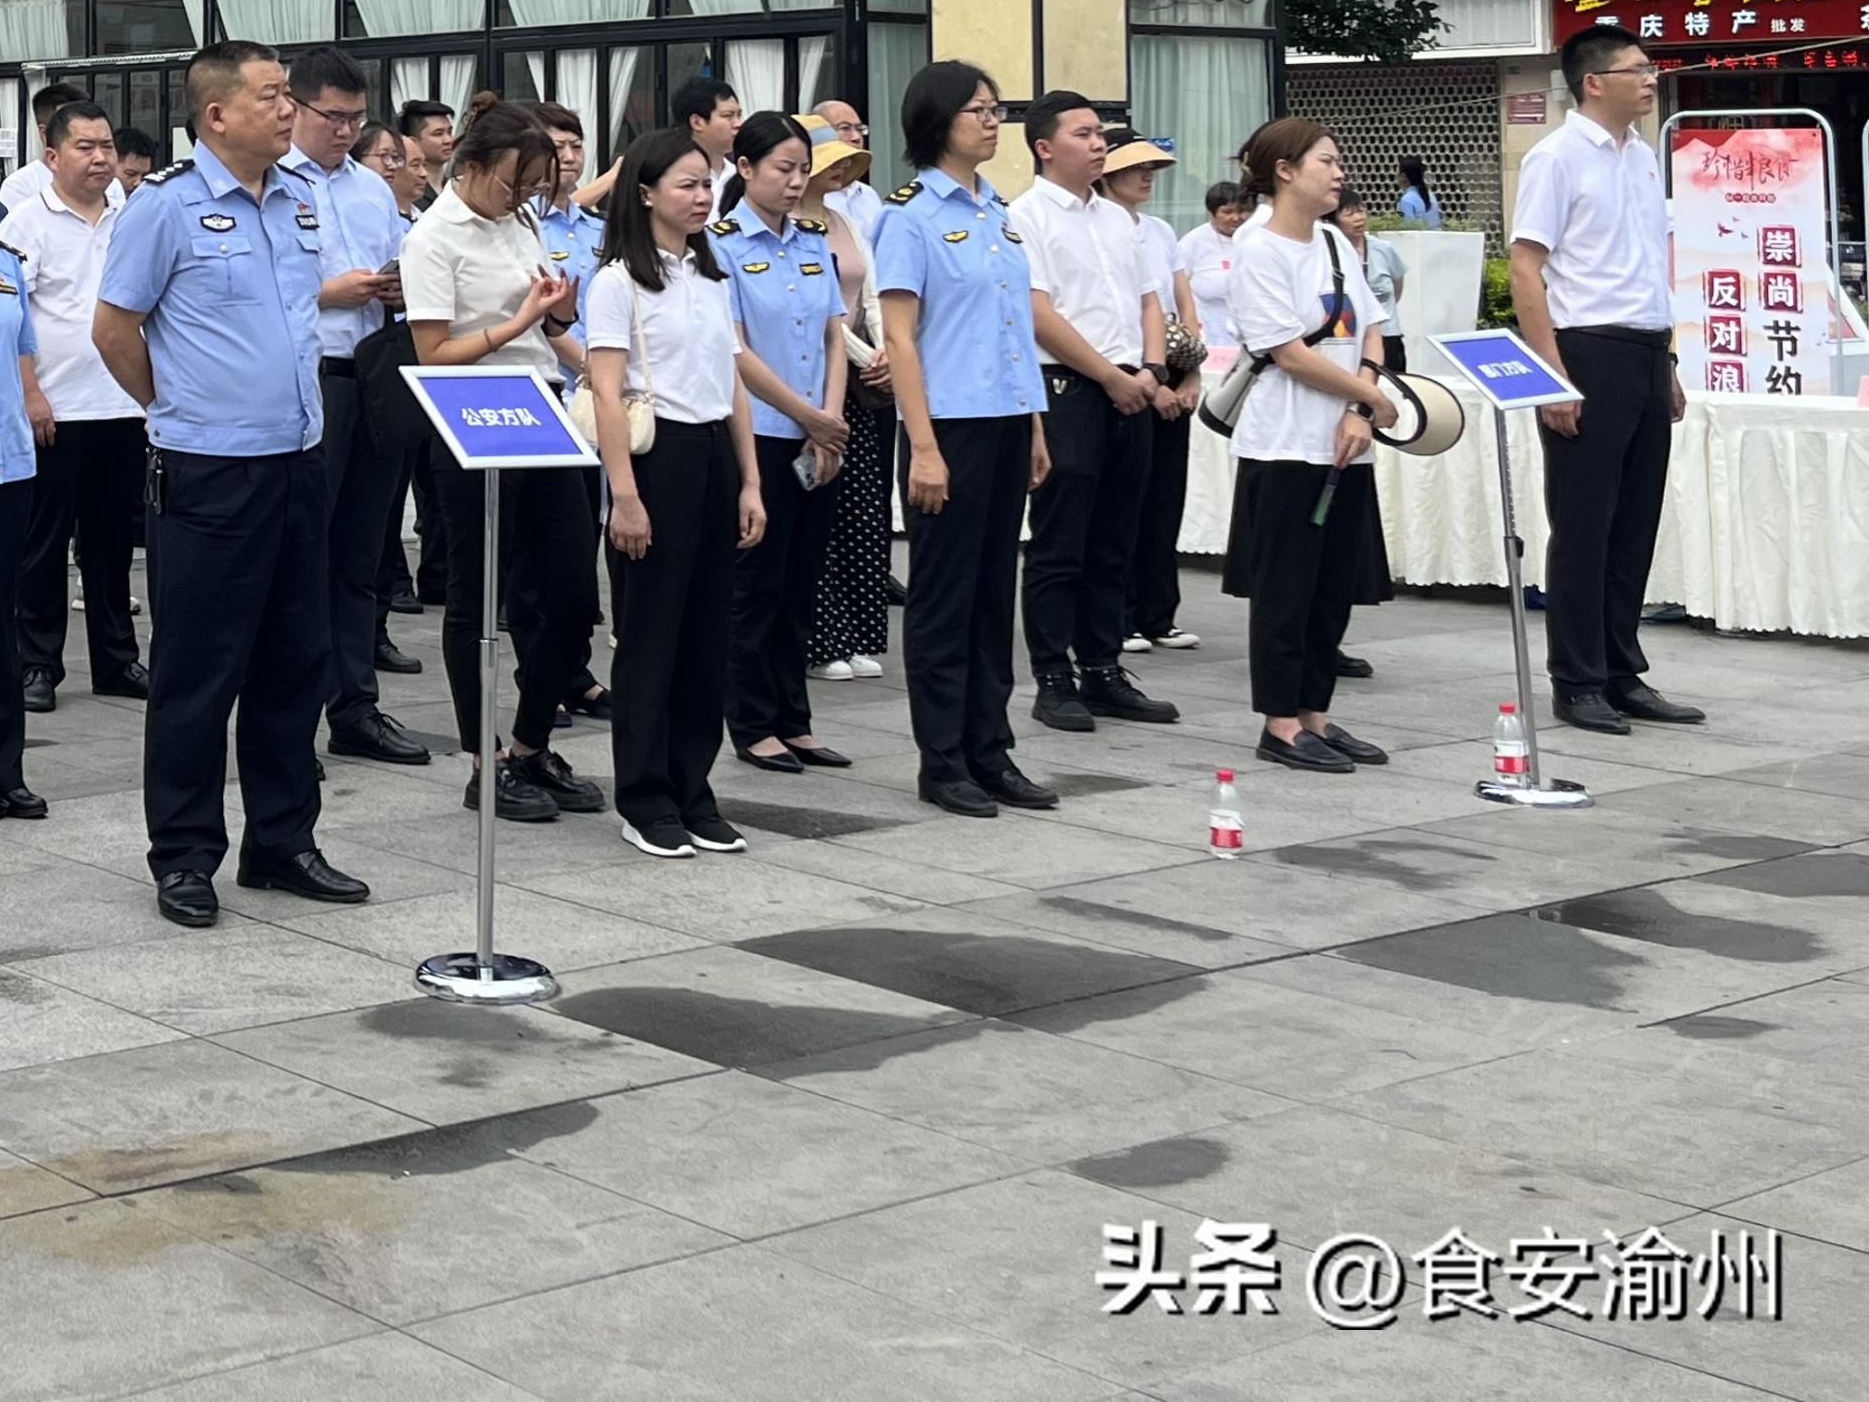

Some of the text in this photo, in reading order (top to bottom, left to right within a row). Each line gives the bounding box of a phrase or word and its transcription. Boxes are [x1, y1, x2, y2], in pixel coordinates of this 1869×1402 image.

[1709, 277, 1741, 392] 反对浪
[1762, 228, 1802, 395] 崇尚节约
[461, 407, 542, 427] 公安方队
